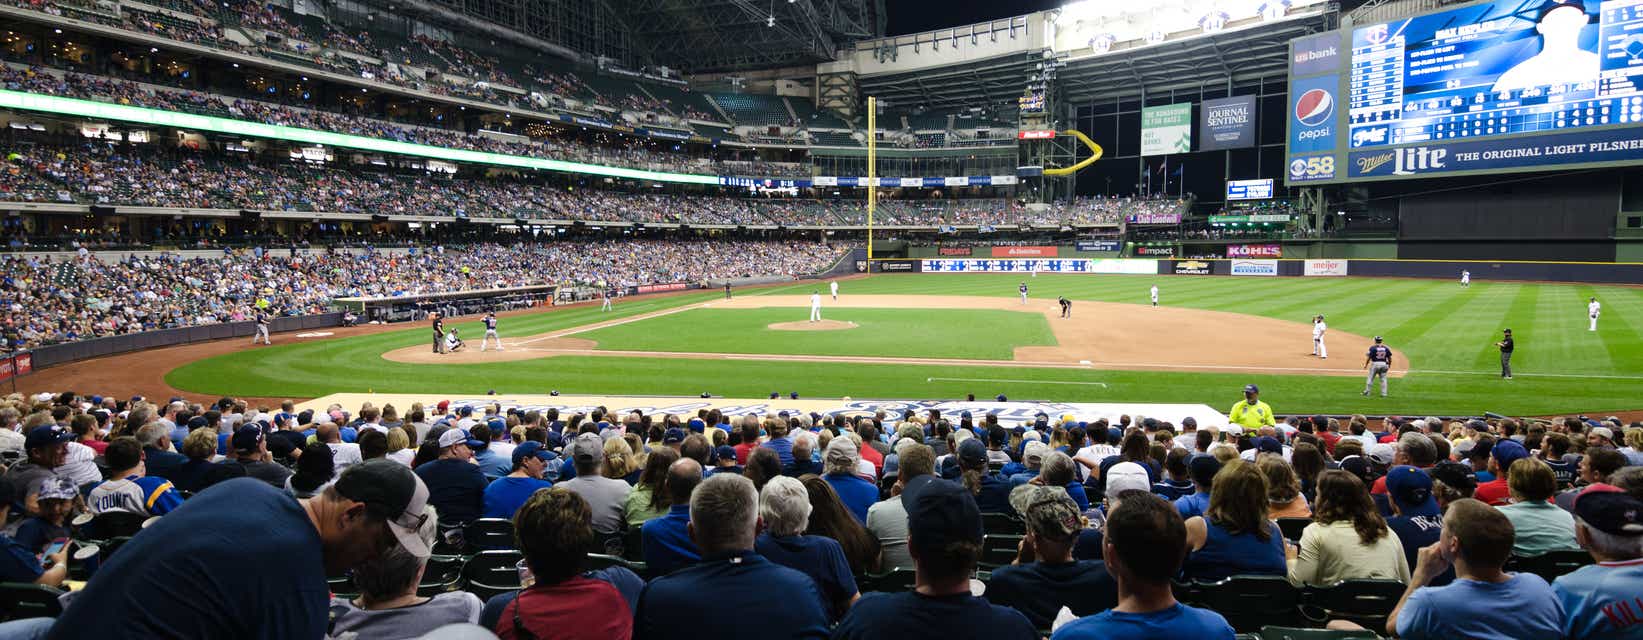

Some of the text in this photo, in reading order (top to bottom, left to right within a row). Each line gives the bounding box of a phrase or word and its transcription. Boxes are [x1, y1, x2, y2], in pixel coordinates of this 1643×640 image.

[1209, 107, 1249, 119] JOURNAL
[1208, 116, 1249, 127] SENTINEL
[1298, 127, 1330, 142] pepsi
[1455, 151, 1480, 162] THE
[1482, 147, 1542, 160] ORIGINAL
[1545, 143, 1586, 155] LIGHT
[1307, 156, 1335, 176] 58
[1356, 147, 1447, 175] Miller Lite
[1143, 247, 1173, 255] impact
[1312, 261, 1338, 270] meijer
